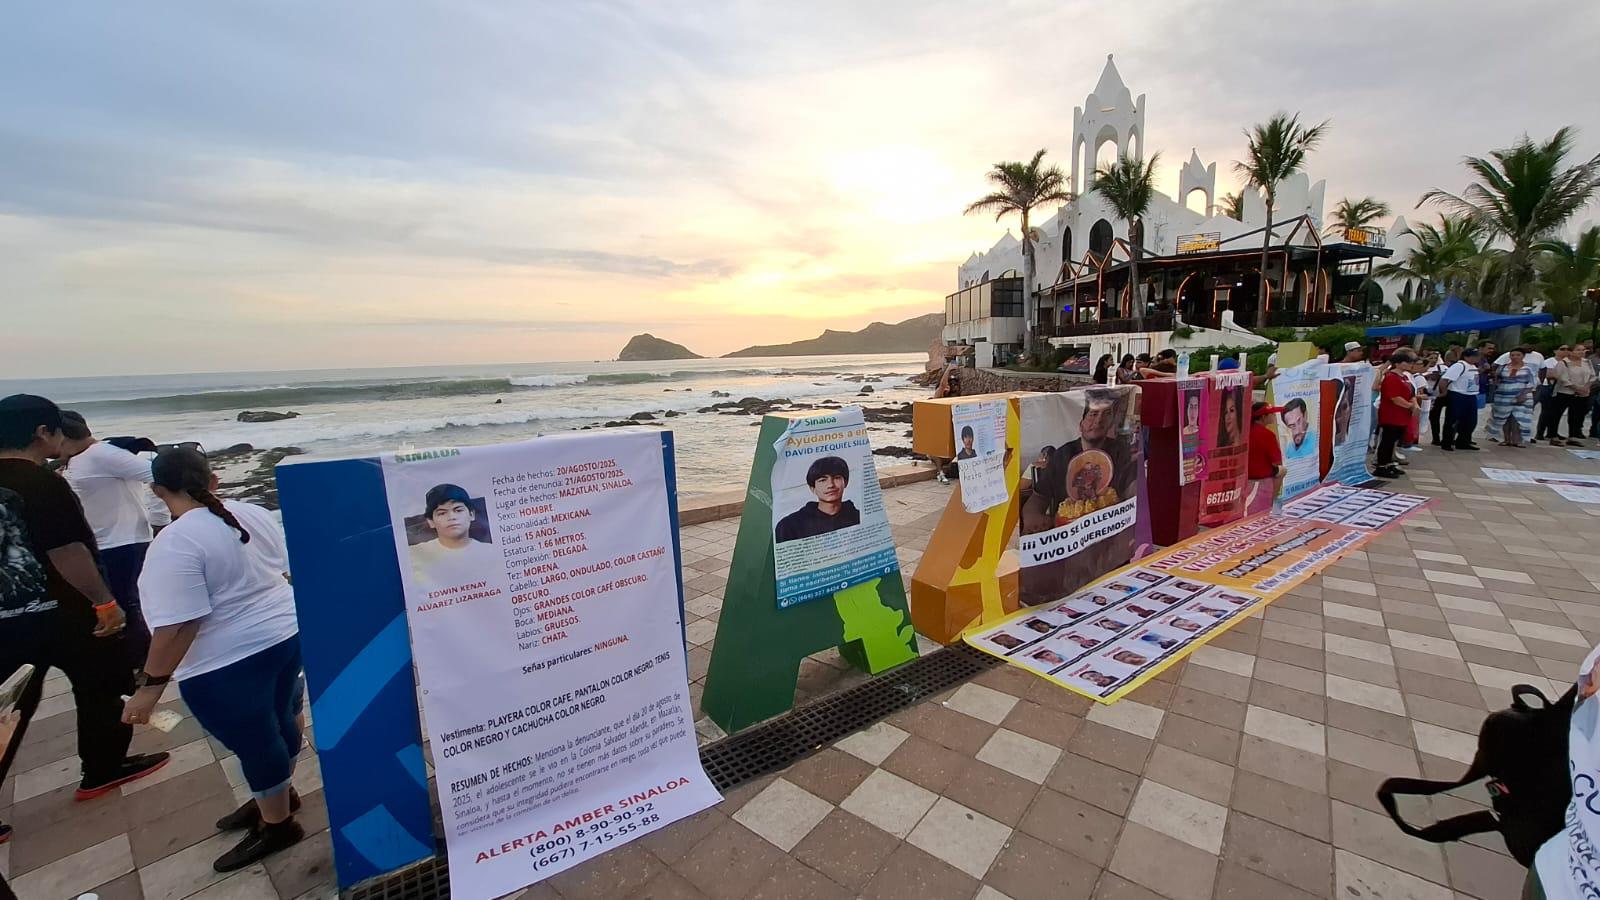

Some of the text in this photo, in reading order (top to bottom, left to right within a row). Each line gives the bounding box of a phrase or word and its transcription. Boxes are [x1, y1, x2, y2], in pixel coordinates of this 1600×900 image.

[804, 416, 836, 426] Sinaloa
[785, 448, 813, 458] DAVID
[816, 442, 852, 453] EZEQUIEL
[492, 476, 514, 485] Fecha
[516, 472, 525, 481] de
[527, 471, 555, 480] hechos:
[494, 487, 516, 496] Fecha
[518, 484, 527, 493] de
[529, 480, 563, 492] denuncia:
[496, 499, 516, 510] Lugar
[519, 496, 528, 504] de
[530, 492, 558, 503] hechos:
[498, 512, 516, 521] Sexo:
[500, 517, 550, 532] Nacionalidad:
[1040, 531, 1068, 545] VIVO
[1070, 526, 1080, 536] SE
[1080, 519, 1091, 529] LO
[1093, 502, 1135, 525] LLEVARON,
[502, 527, 559, 545] Edad: 15 AÑOS.
[504, 533, 586, 557] Estatura: 1.66 METROS.
[506, 553, 551, 568] Complexión:
[1033, 547, 1065, 561] VIVO
[1068, 541, 1079, 552] LO
[507, 572, 522, 580] Tez:
[510, 546, 666, 592] Cabello: LARGO, ONDULADO, COLOR CASTAÑO
[417, 588, 501, 612] ALVAREZ LIZARRAGA
[428, 581, 487, 598] EDWIN KENAY
[513, 607, 532, 617] Ojos:
[534, 595, 570, 611] GRANDES
[571, 588, 596, 600] COLOR
[597, 582, 613, 594] CAFÉ
[514, 618, 535, 628] Boca:
[516, 628, 542, 640] Labios:
[518, 640, 541, 651] Nariz:
[522, 661, 545, 675] Señas
[547, 646, 593, 669] particulares:
[440, 724, 485, 743] Vestimenta:
[488, 709, 524, 729] PLAYERA
[524, 700, 551, 716] COLOR
[574, 679, 610, 700] PANTALON
[611, 670, 633, 686] COLOR
[655, 651, 671, 665] TENIS
[443, 741, 473, 758] COLOR
[474, 731, 503, 749] NEGRO
[505, 729, 510, 739] Y
[512, 714, 554, 736] CACHUCHA
[555, 704, 580, 720] COLOR
[451, 772, 488, 794] RESUMEN
[490, 767, 500, 779] DE
[502, 756, 533, 775] HECHOS:
[535, 745, 565, 761] Menciona
[567, 740, 573, 749] la
[613, 720, 624, 730] que
[626, 714, 631, 724] el
[641, 706, 647, 717] 20
[649, 703, 654, 712] de
[656, 696, 671, 709] agosto
[674, 691, 680, 700] de
[453, 793, 473, 808] 2025,
[476, 789, 482, 798] el
[486, 774, 526, 795] adolescente
[529, 770, 536, 778] se
[540, 765, 545, 774] le
[548, 761, 558, 770] vio
[560, 757, 568, 765] en
[571, 752, 576, 760] la
[579, 743, 601, 757] Colonia
[603, 732, 627, 747] Salvador
[650, 716, 656, 724] en
[454, 806, 482, 820] Sinaloa,
[485, 802, 489, 812] y
[492, 792, 510, 806] hasta
[513, 788, 519, 796] el
[521, 775, 555, 793] momento,
[557, 770, 565, 779] no
[568, 767, 574, 775] se
[577, 758, 595, 770] tienen
[611, 745, 627, 756] datos
[630, 736, 643, 748] sobre
[678, 716, 684, 724] Se
[457, 815, 490, 830] considera
[492, 808, 505, 818] que
[516, 789, 548, 808] integridad
[550, 780, 573, 795] pudiera
[575, 765, 609, 783] encontrarse
[638, 746, 650, 757] toda
[659, 736, 668, 745] que
[670, 728, 686, 743] puede
[475, 777, 691, 864] ALERTA AMBER SINALOA
[529, 802, 654, 858] (800) 8-90-90-92
[532, 814, 660, 872] (667) 7-15-55-88
